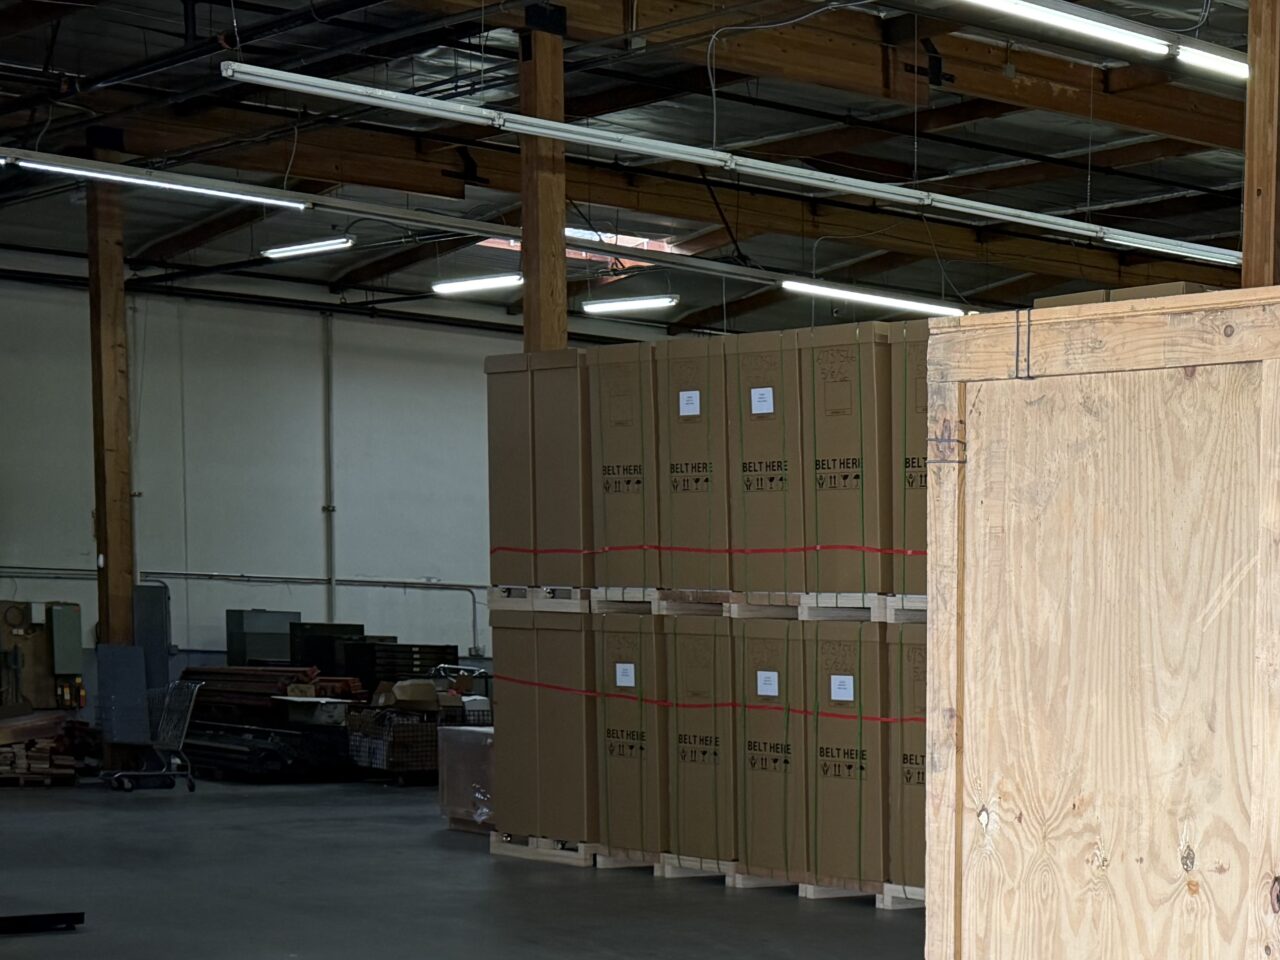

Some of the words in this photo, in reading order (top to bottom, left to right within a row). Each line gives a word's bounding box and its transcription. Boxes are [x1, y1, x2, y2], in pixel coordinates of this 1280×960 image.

[670, 463, 690, 474] BELT
[691, 462, 713, 473] HERE
[742, 461, 764, 473] BELT
[765, 460, 788, 472] HERE
[815, 458, 838, 470] BELT
[905, 457, 928, 469] BELT
[602, 464, 621, 476] BELT
[622, 464, 643, 475] HERE
[606, 728, 624, 740] BELT
[678, 733, 698, 746] BELT
[747, 740, 768, 752] BELT
[818, 746, 841, 759] BELT
[902, 753, 926, 766] BELT
